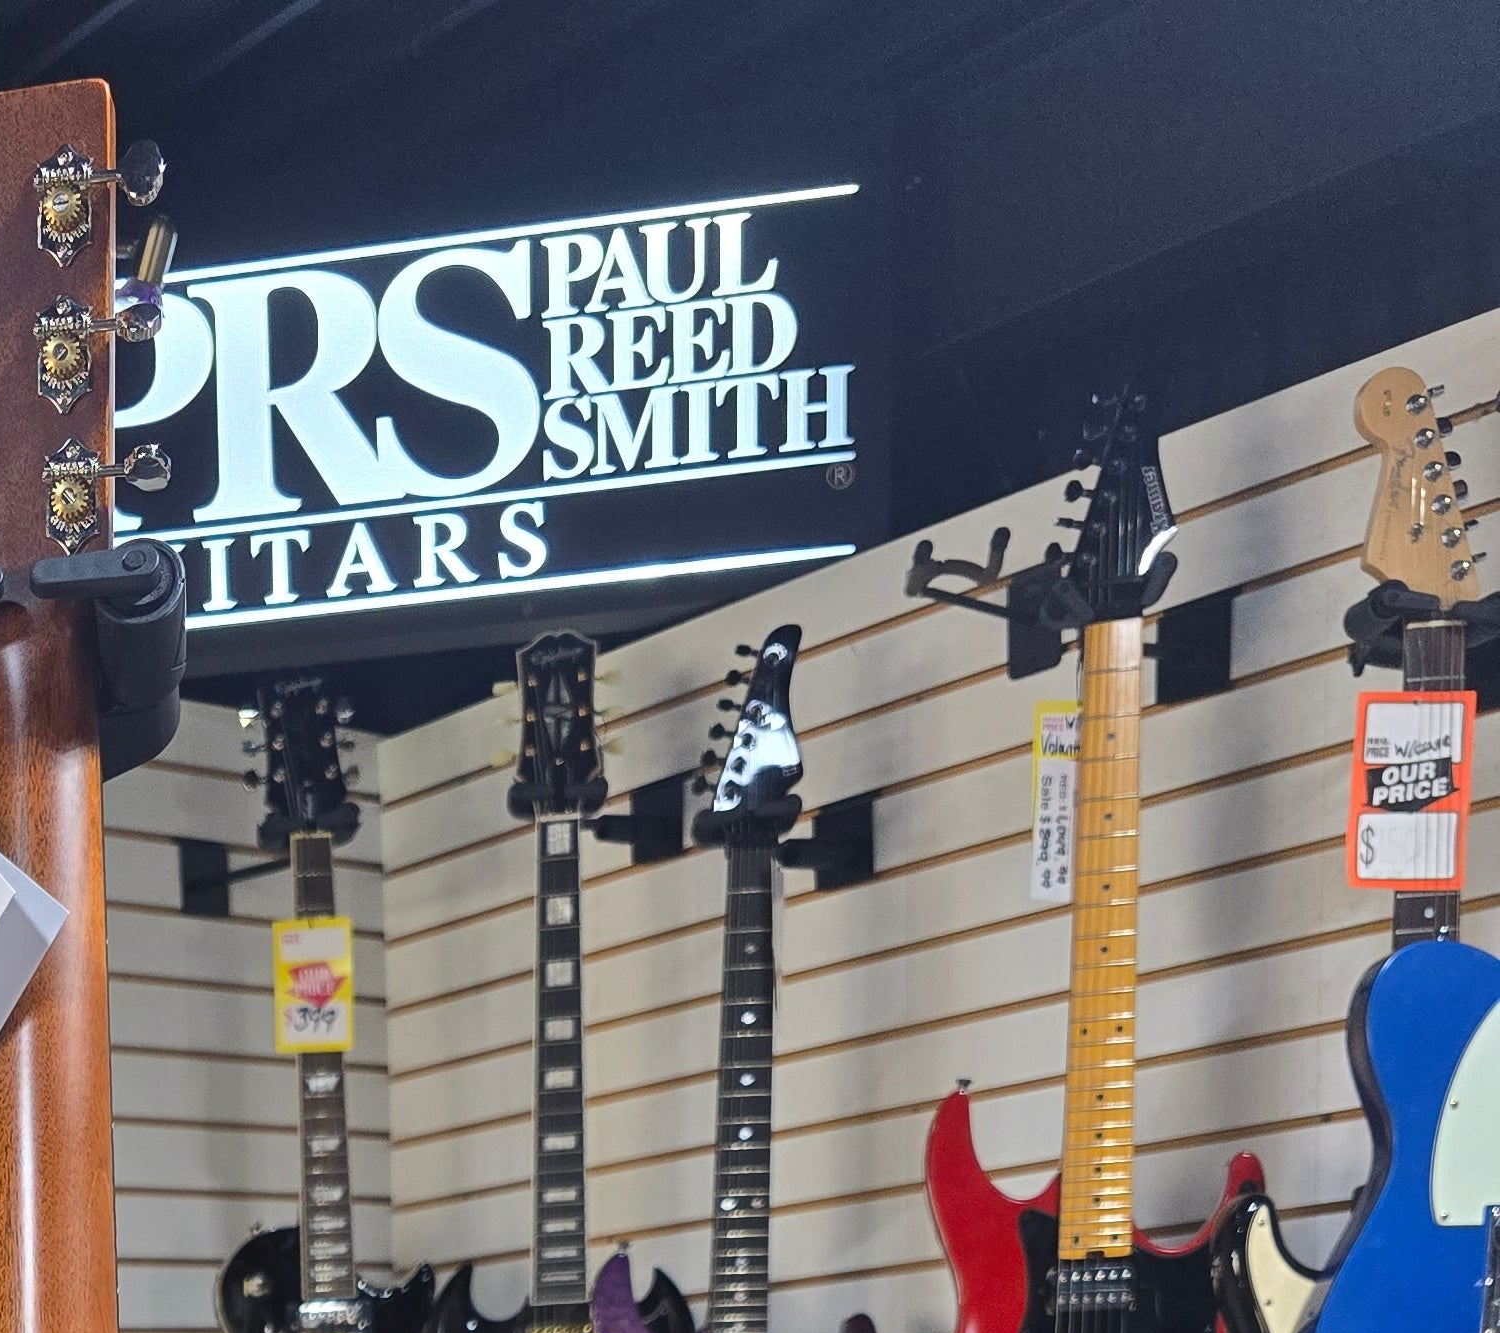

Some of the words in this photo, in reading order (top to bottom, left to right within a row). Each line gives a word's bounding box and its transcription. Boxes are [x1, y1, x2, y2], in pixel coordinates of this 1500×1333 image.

[541, 212, 778, 319] PAUL
[115, 239, 541, 530] PRS
[542, 292, 799, 400] REED
[543, 364, 856, 481] SMITH
[171, 501, 548, 612] ITARS
[1372, 776, 1449, 806] PRICE
[1381, 762, 1437, 786] OUR
